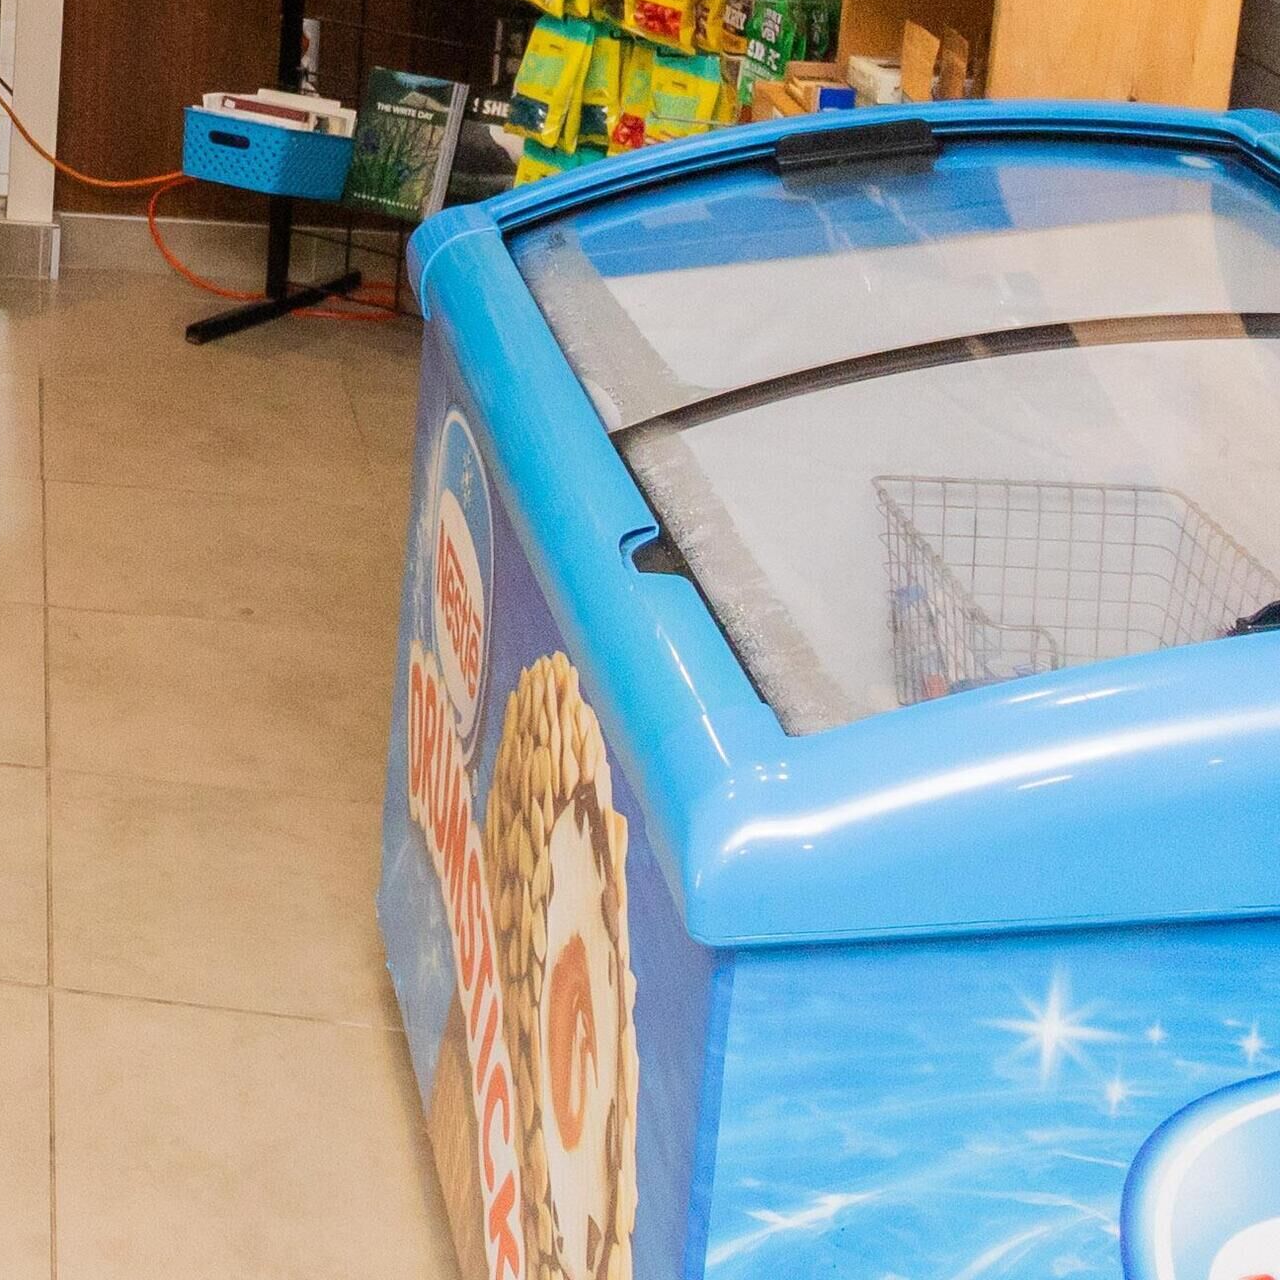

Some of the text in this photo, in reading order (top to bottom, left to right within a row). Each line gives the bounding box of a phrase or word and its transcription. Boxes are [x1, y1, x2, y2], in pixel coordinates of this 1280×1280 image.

[377, 102, 434, 121] THE WRITE DAY
[435, 520, 482, 700] Nestlé
